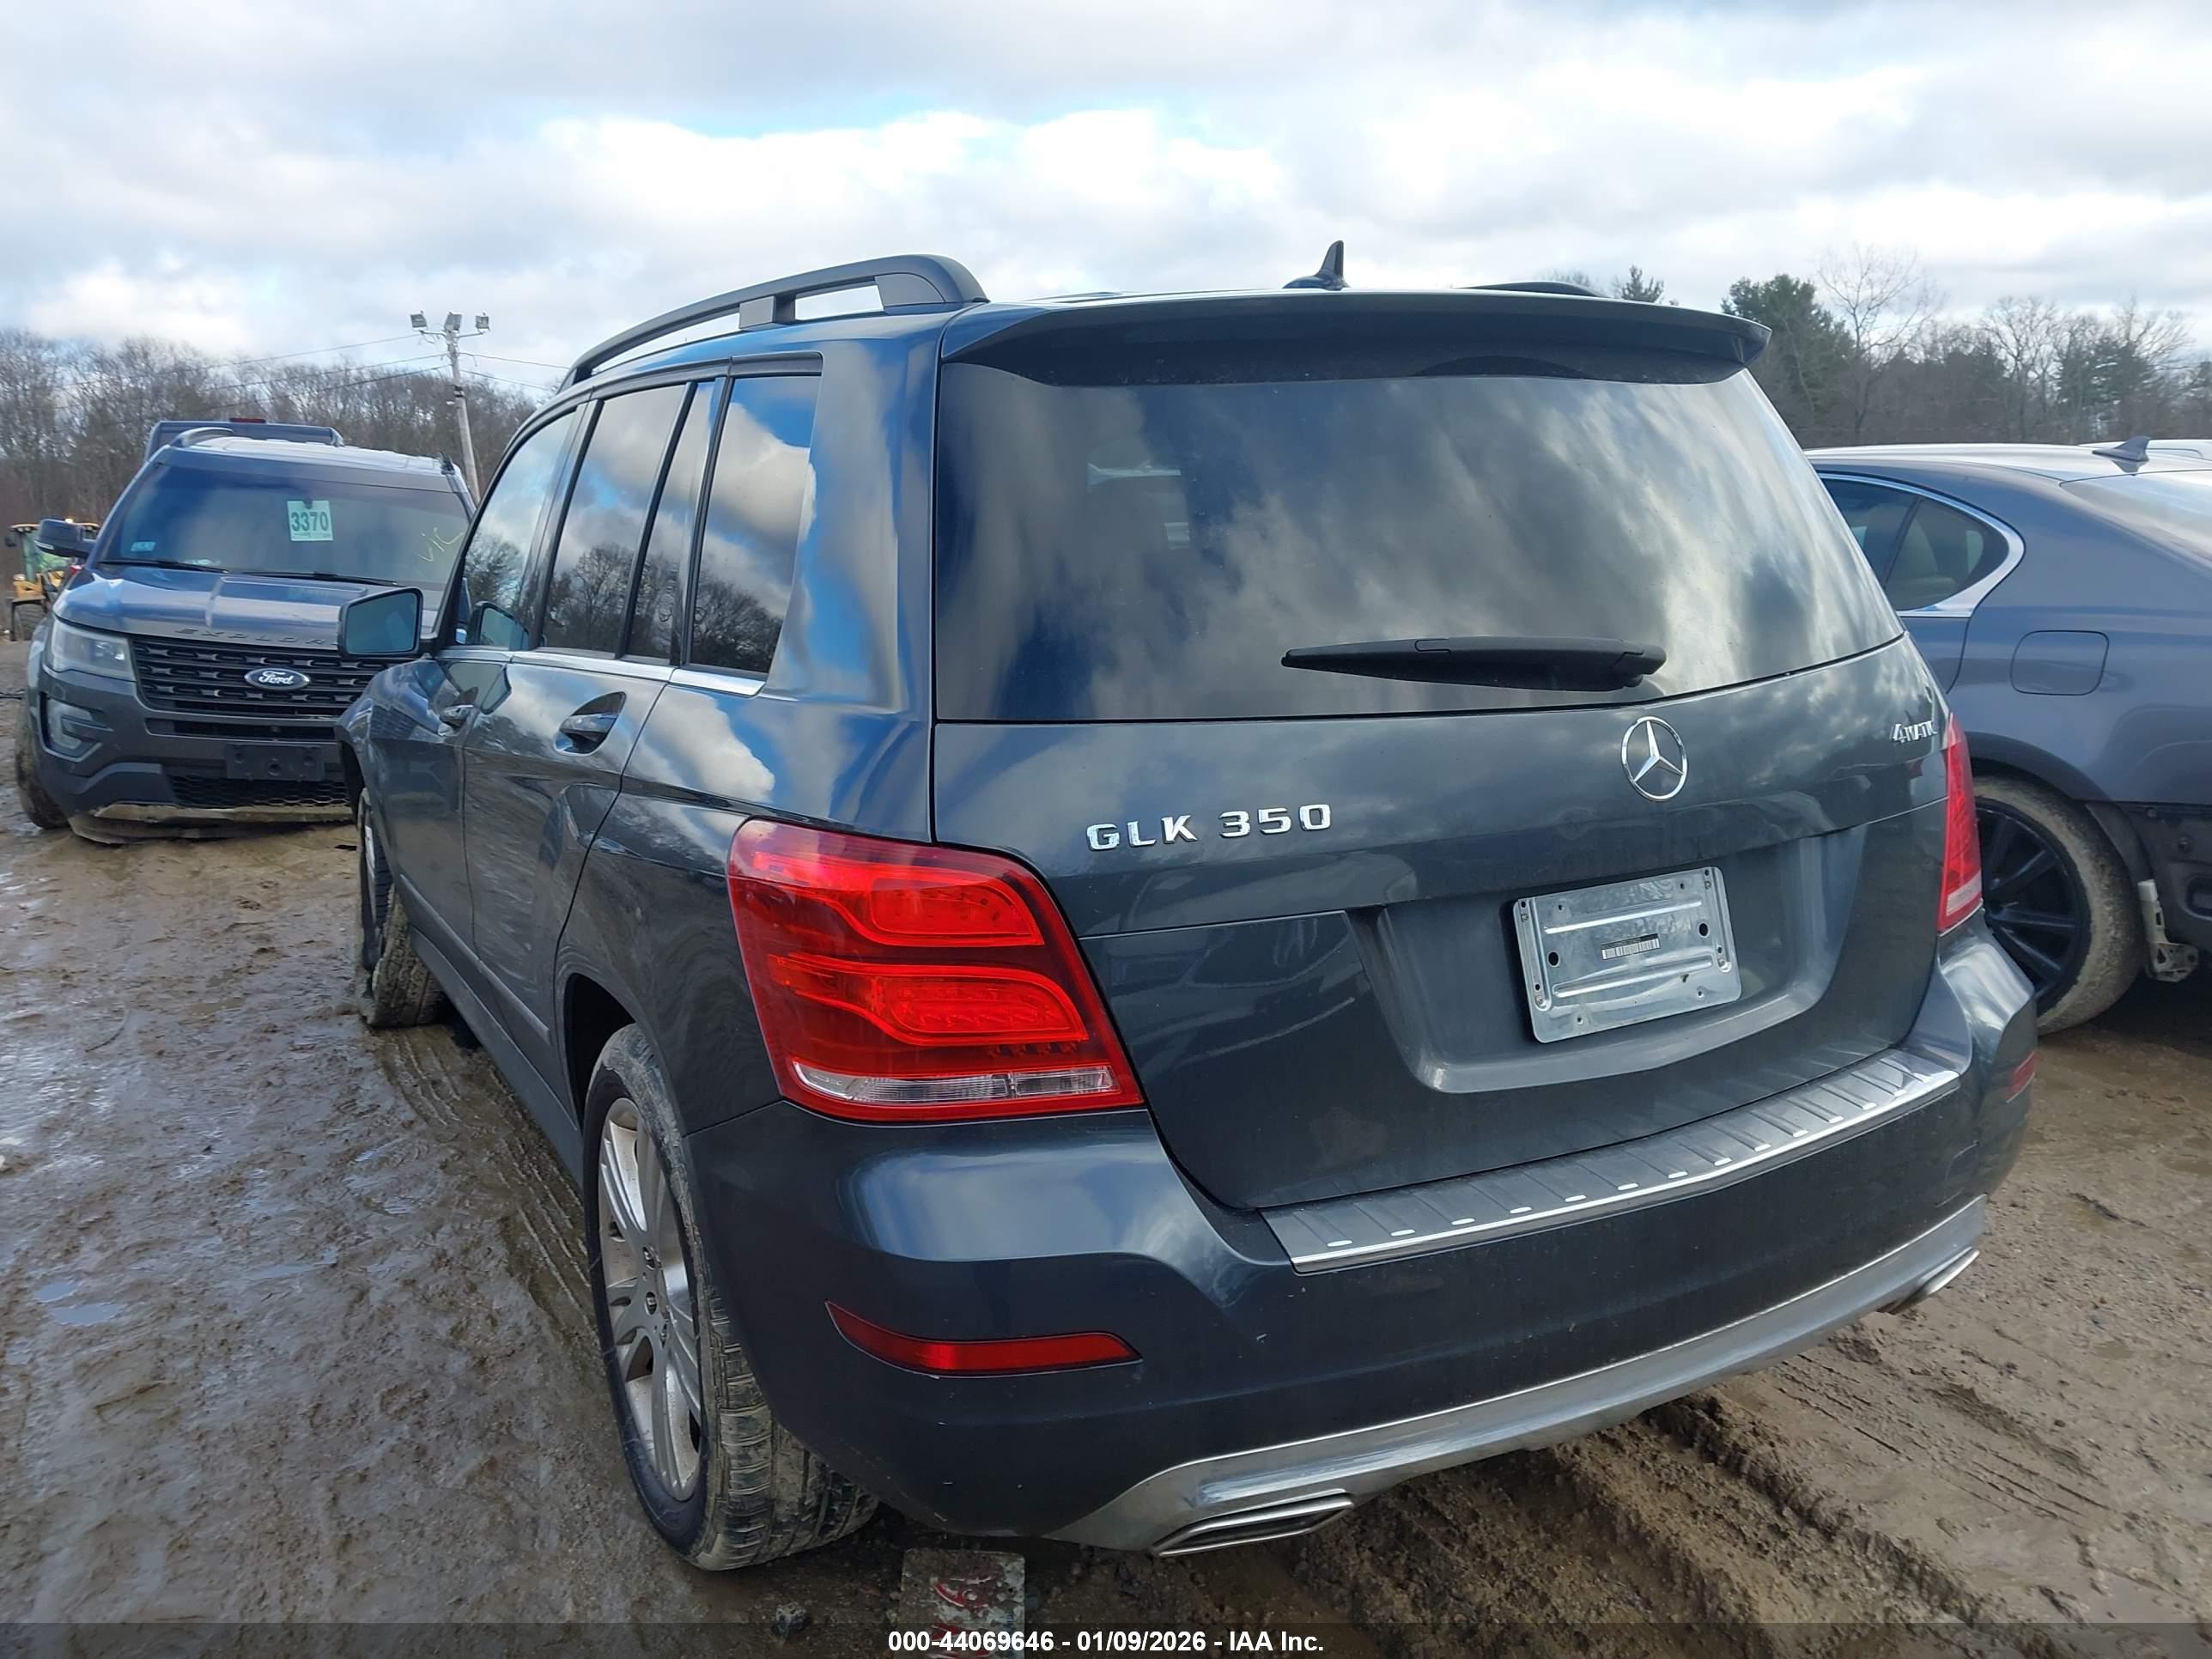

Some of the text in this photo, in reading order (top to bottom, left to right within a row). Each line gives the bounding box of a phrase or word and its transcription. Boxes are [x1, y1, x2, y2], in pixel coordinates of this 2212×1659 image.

[290, 511, 329, 532] 3370
[174, 628, 337, 646] EXPLOR
[258, 671, 295, 685] Ford
[1086, 804, 1332, 851] GLK 350
